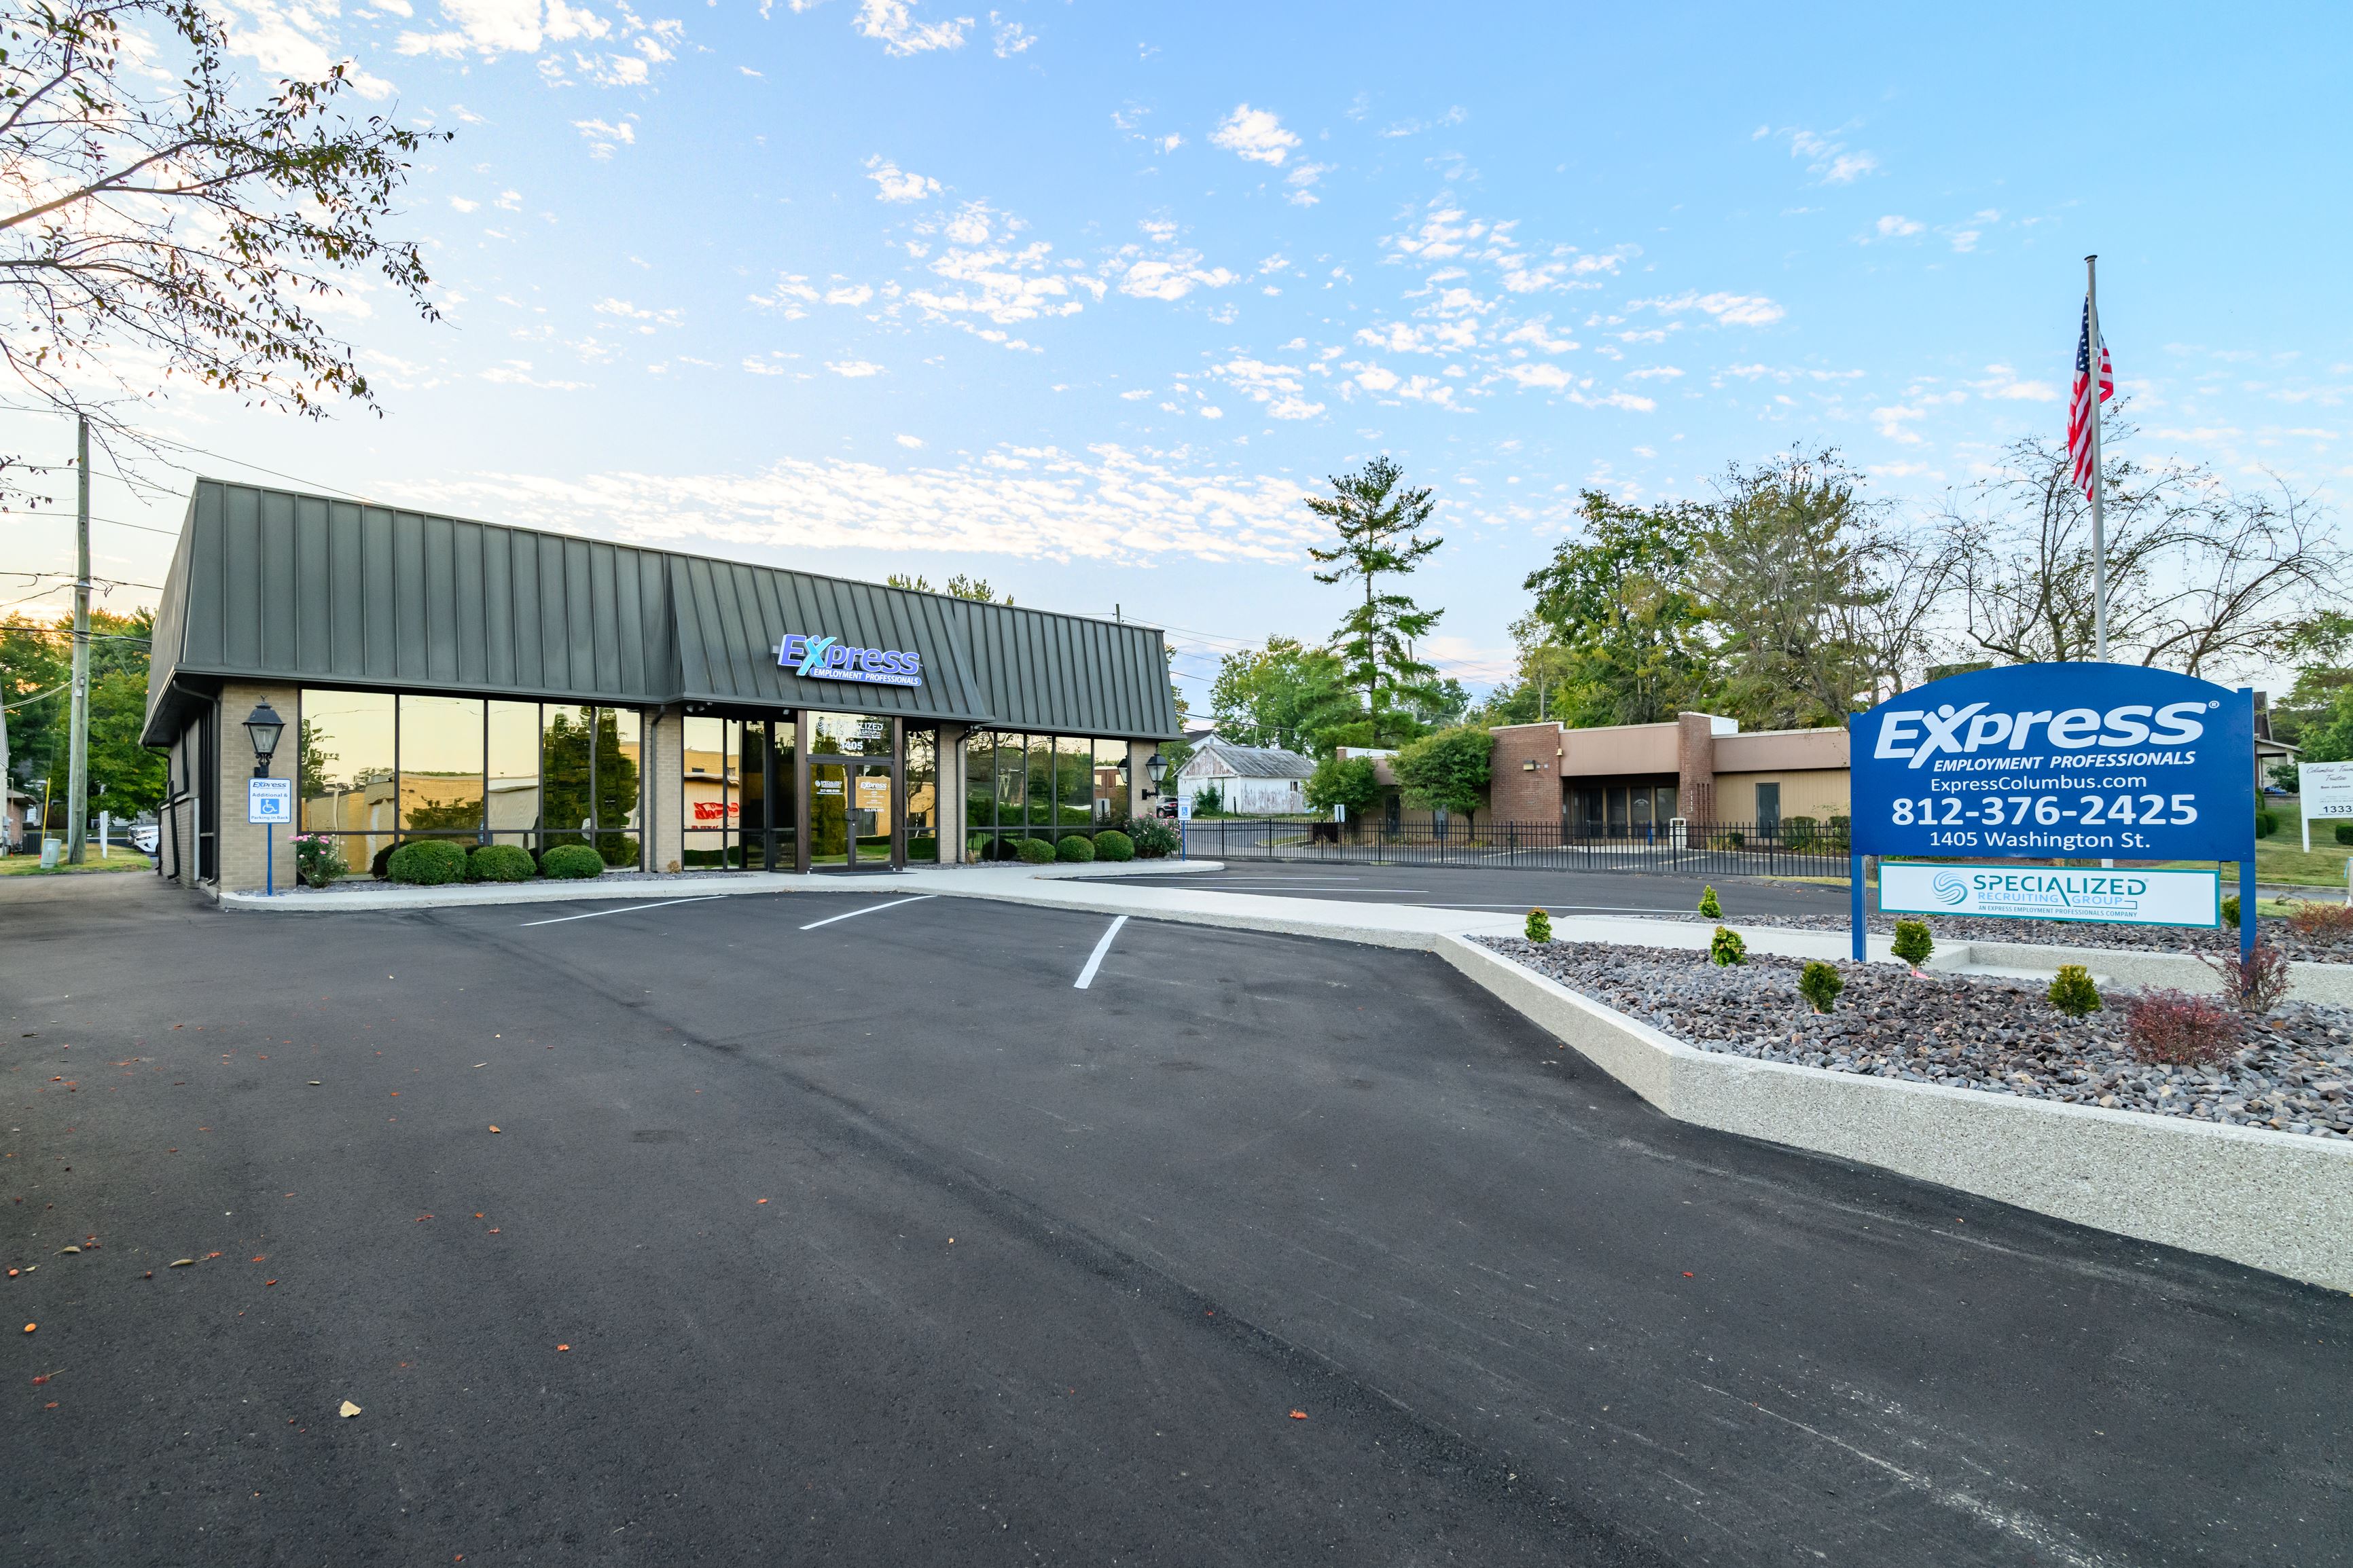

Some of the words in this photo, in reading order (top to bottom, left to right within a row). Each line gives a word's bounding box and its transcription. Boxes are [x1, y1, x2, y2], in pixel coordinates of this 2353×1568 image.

[777, 634, 920, 676] Express
[814, 668, 863, 680] EMPLOYMENT
[865, 674, 918, 685] PROFESSIONALS
[1874, 701, 2207, 769] Express
[1933, 756, 2044, 772] EMPLOYMENT
[2049, 750, 2196, 769] PROFESSIONALS
[860, 782, 887, 790] Express
[1930, 774, 2147, 795] ExpressColumbus.com
[1891, 794, 2197, 826] 812-376-2425
[2322, 805, 2352, 814] 1333
[1930, 831, 1978, 847] 1405
[1984, 831, 2113, 851] Washington
[2121, 832, 2151, 848] St.
[1973, 875, 2147, 907] SPECIALIZED
[1978, 892, 2059, 903] RECRUITING
[2072, 895, 2123, 905] GROUP
